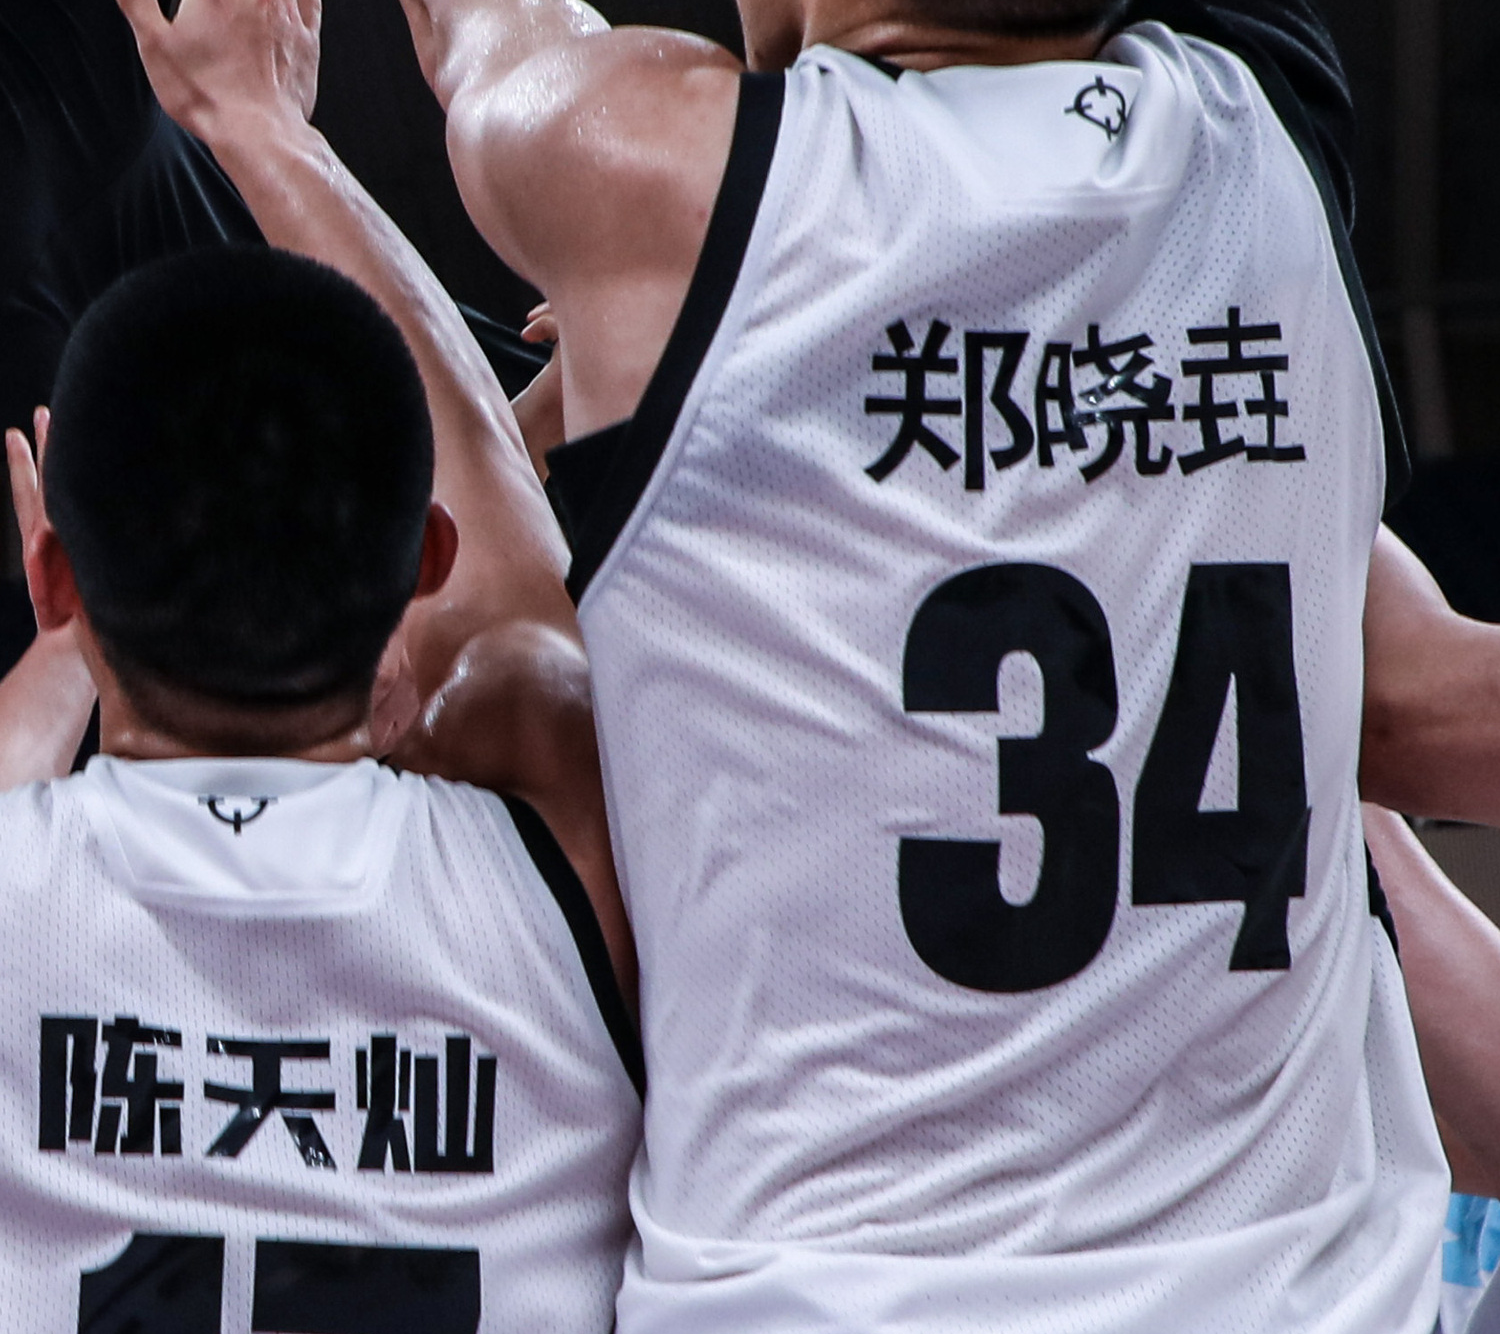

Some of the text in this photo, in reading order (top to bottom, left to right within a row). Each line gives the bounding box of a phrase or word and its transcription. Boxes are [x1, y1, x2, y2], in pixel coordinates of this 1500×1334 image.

[864, 307, 1306, 490] 郑晓垚
[899, 562, 1311, 993] 34
[38, 1014, 498, 1174] 陈天灿
